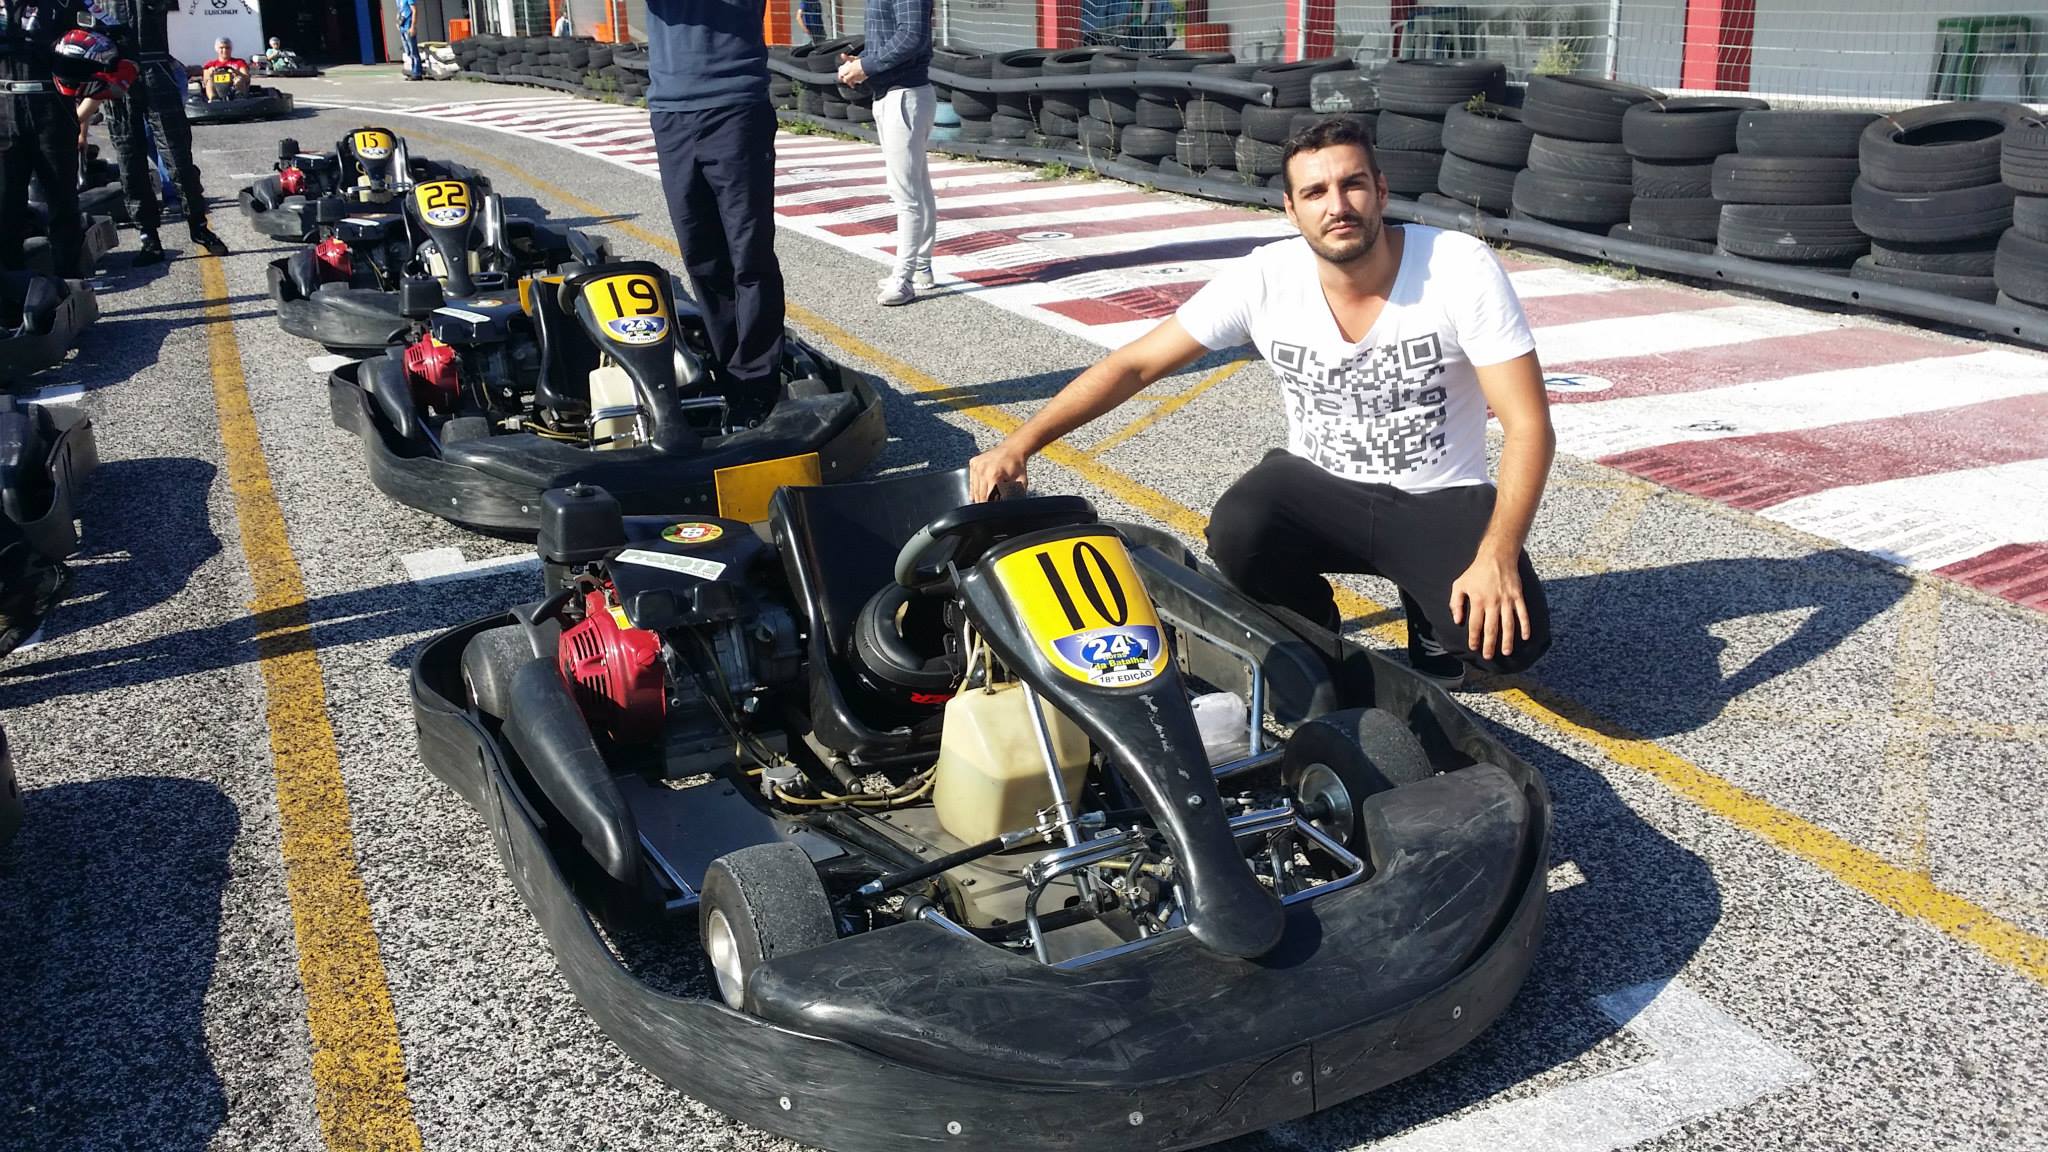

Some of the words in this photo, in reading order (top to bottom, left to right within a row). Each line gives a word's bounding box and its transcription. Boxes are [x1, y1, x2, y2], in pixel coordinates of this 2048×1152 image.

[362, 133, 379, 148] 15
[424, 184, 466, 209] 22
[607, 279, 659, 318] 19
[1036, 541, 1128, 631] 10
[1088, 635, 1131, 661] 24
[1109, 657, 1146, 667] Batalha
[1117, 670, 1152, 682] EDIÇÃO
